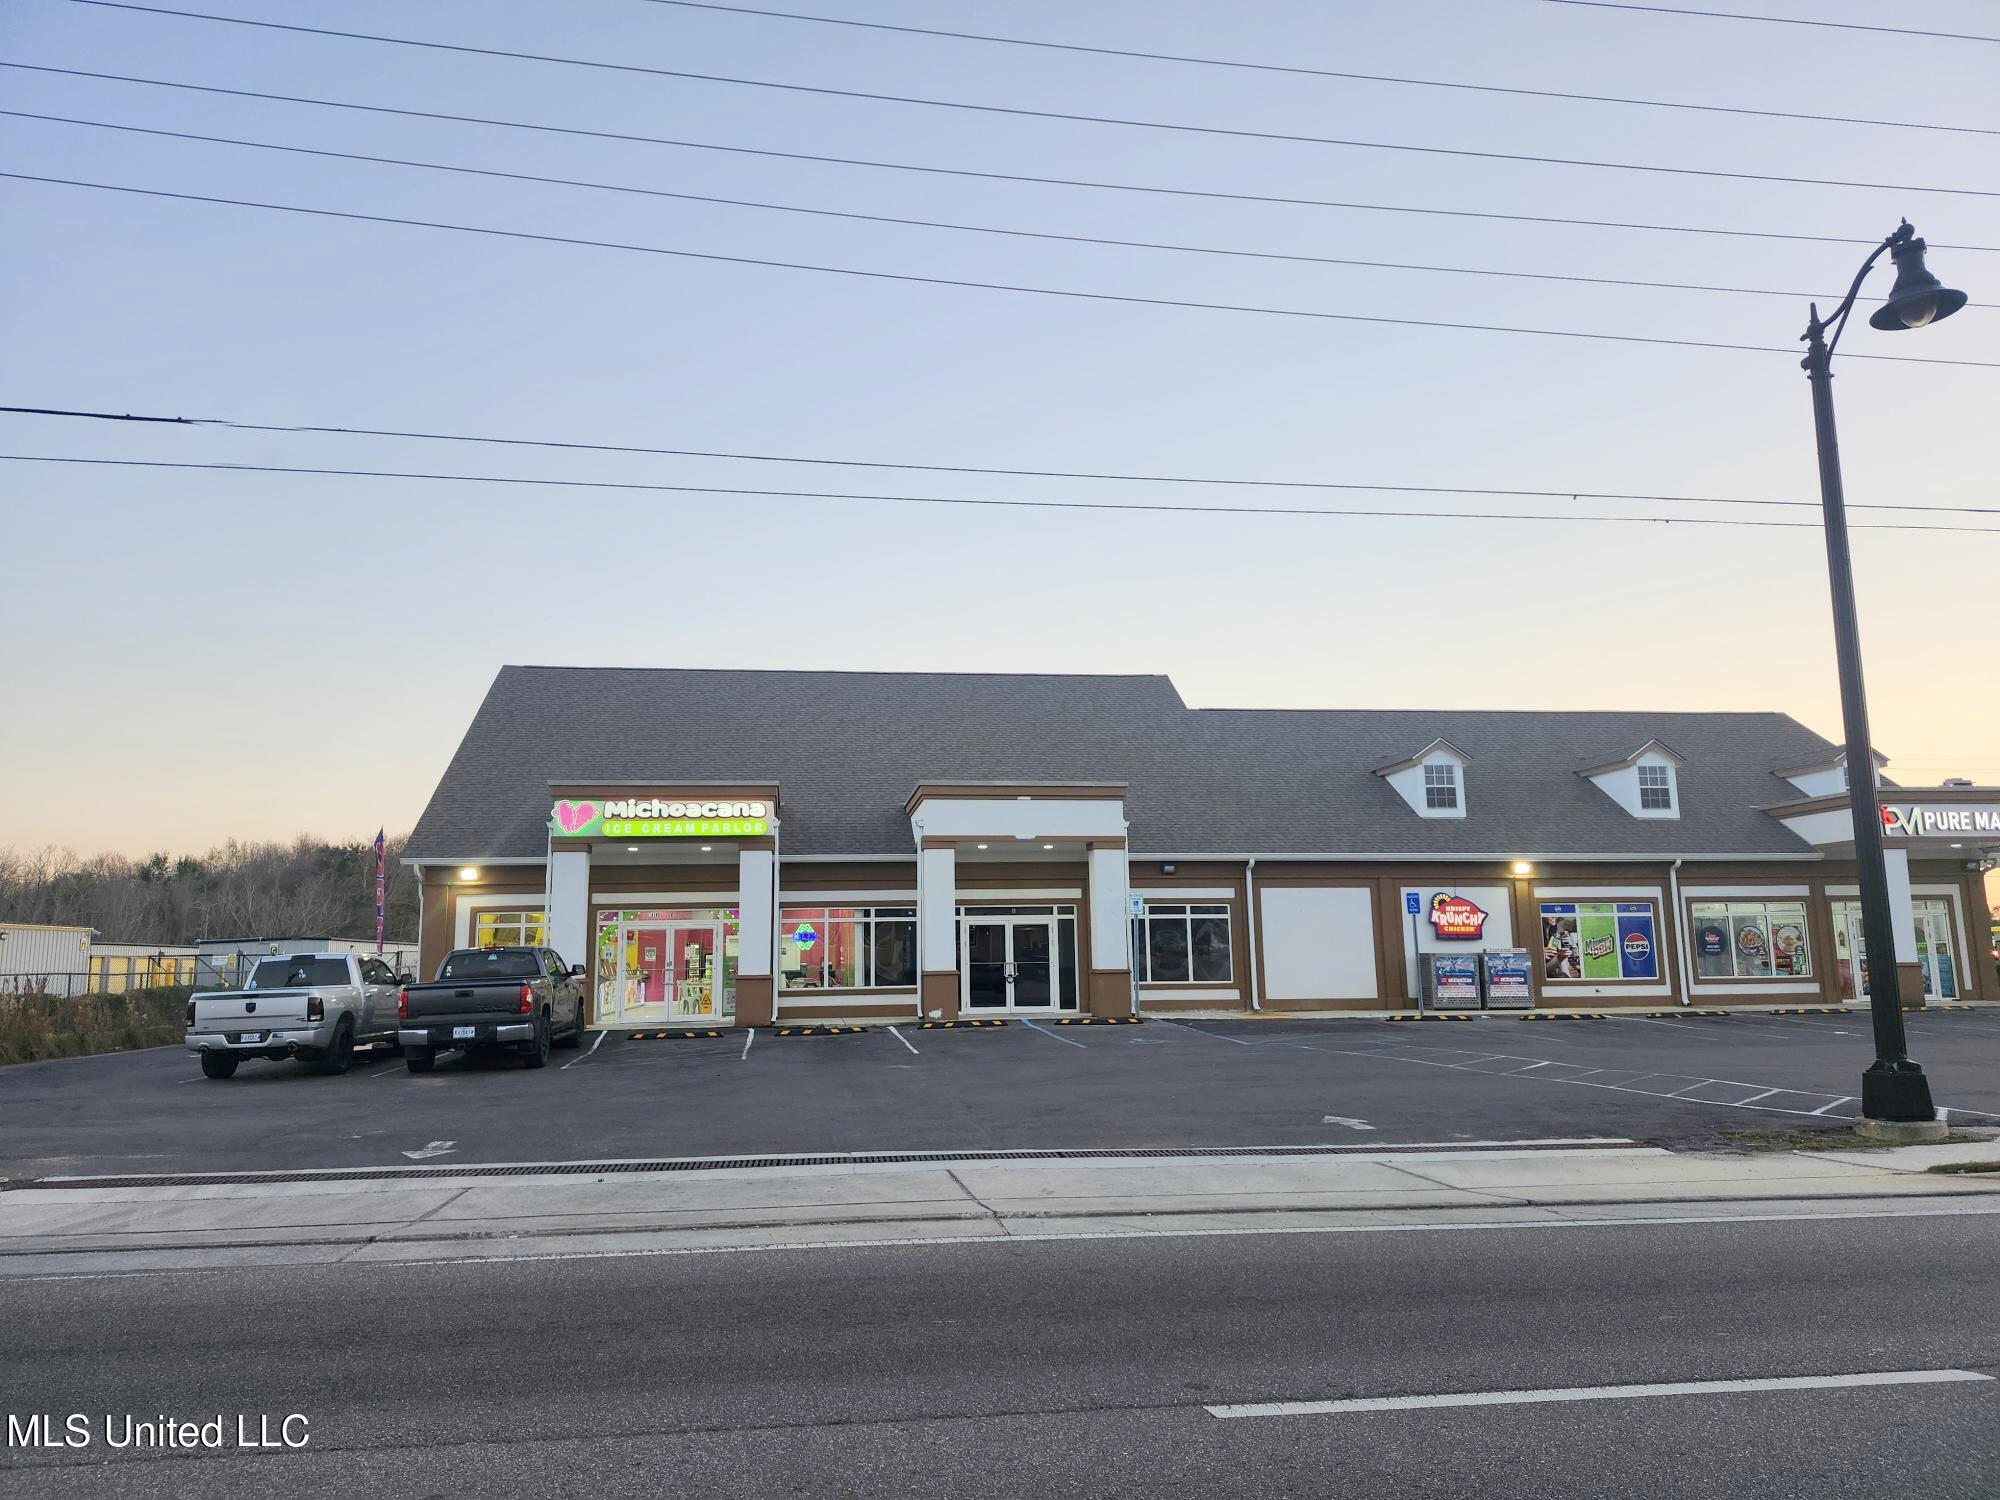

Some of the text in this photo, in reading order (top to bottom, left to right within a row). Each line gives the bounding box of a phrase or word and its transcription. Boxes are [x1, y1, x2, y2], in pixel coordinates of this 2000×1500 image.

[603, 799, 766, 819] Michoacana
[605, 822, 763, 834] ICE CREAM PARLOR
[1923, 811, 1972, 830] PURE
[1431, 910, 1487, 926] KRUNCHY
